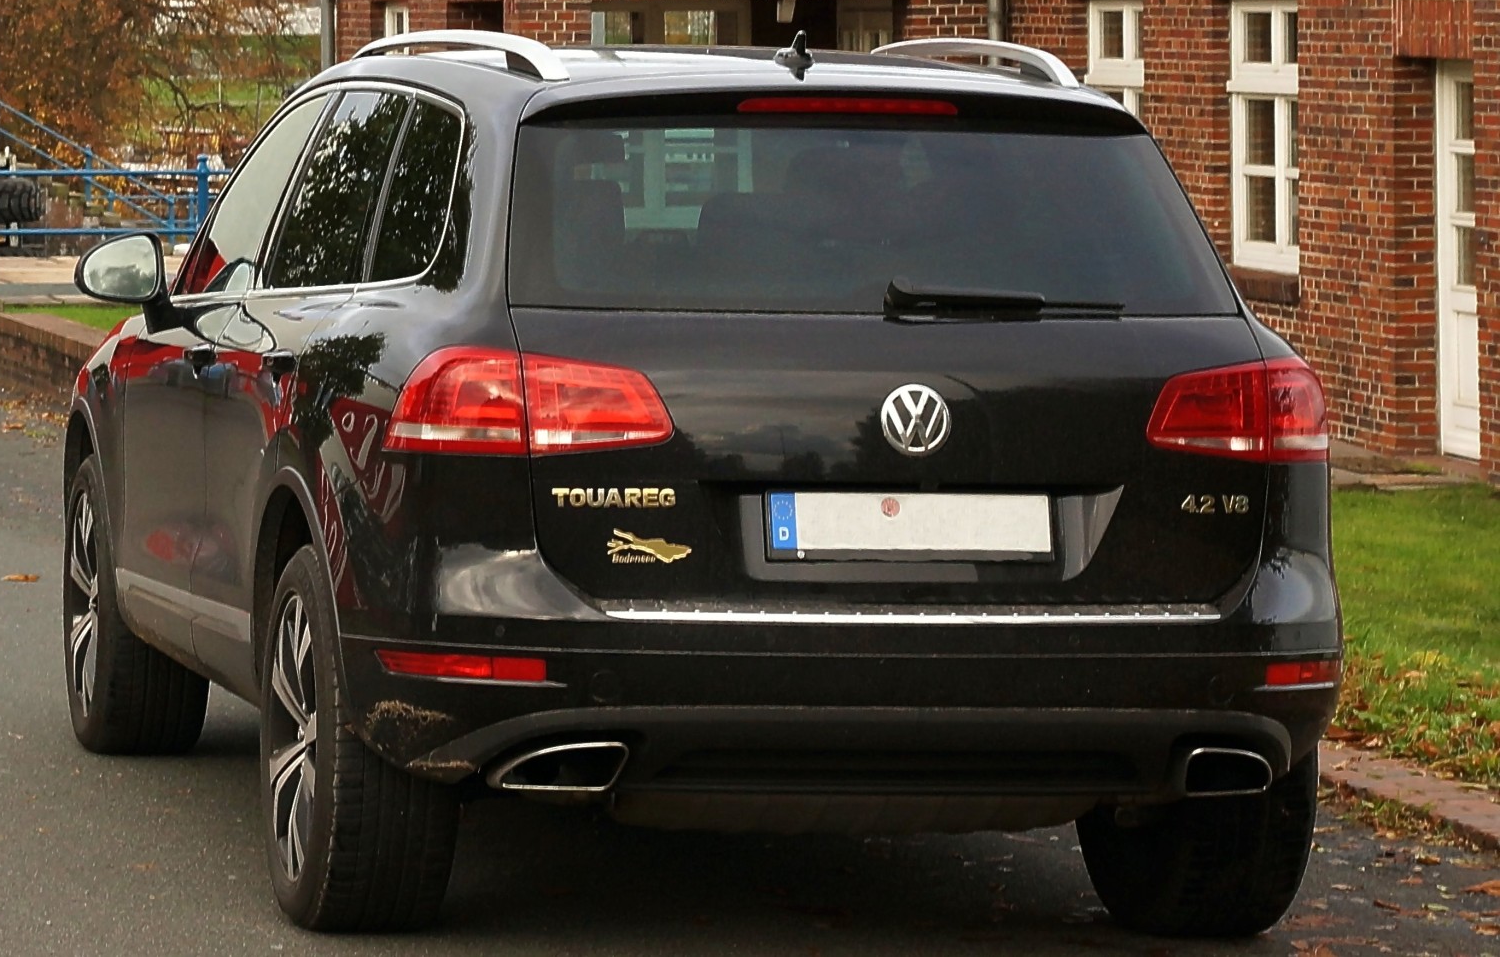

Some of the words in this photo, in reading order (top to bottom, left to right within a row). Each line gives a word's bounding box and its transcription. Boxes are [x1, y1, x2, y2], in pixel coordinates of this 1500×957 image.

[551, 487, 677, 508] TOUAREG
[1181, 494, 1215, 514] 4.2
[1222, 494, 1249, 514] V8
[779, 526, 790, 541] D
